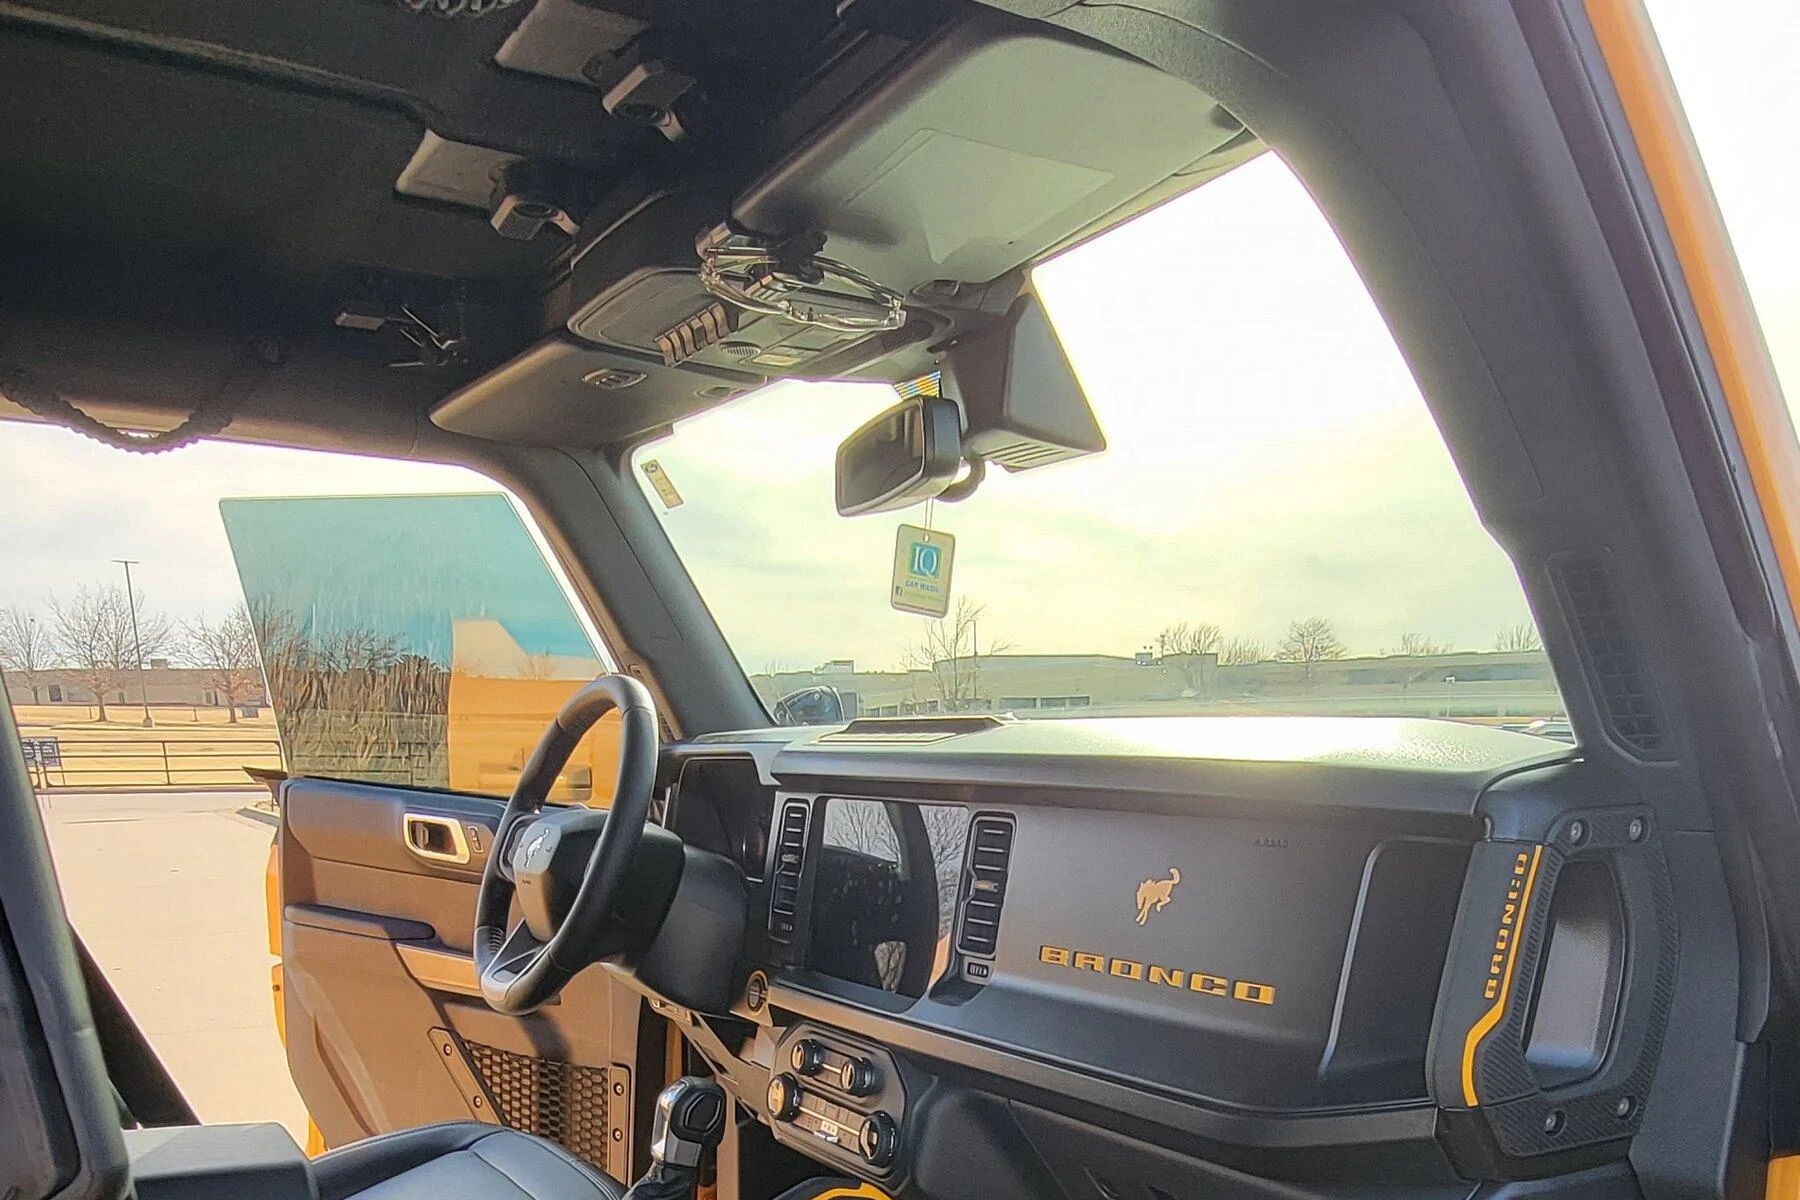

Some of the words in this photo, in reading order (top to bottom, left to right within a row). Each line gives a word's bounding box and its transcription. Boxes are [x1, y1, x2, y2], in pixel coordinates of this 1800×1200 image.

[913, 545, 938, 577] IQ
[1484, 853, 1527, 999] BRONCO
[1039, 945, 1276, 1005] BRONCO
